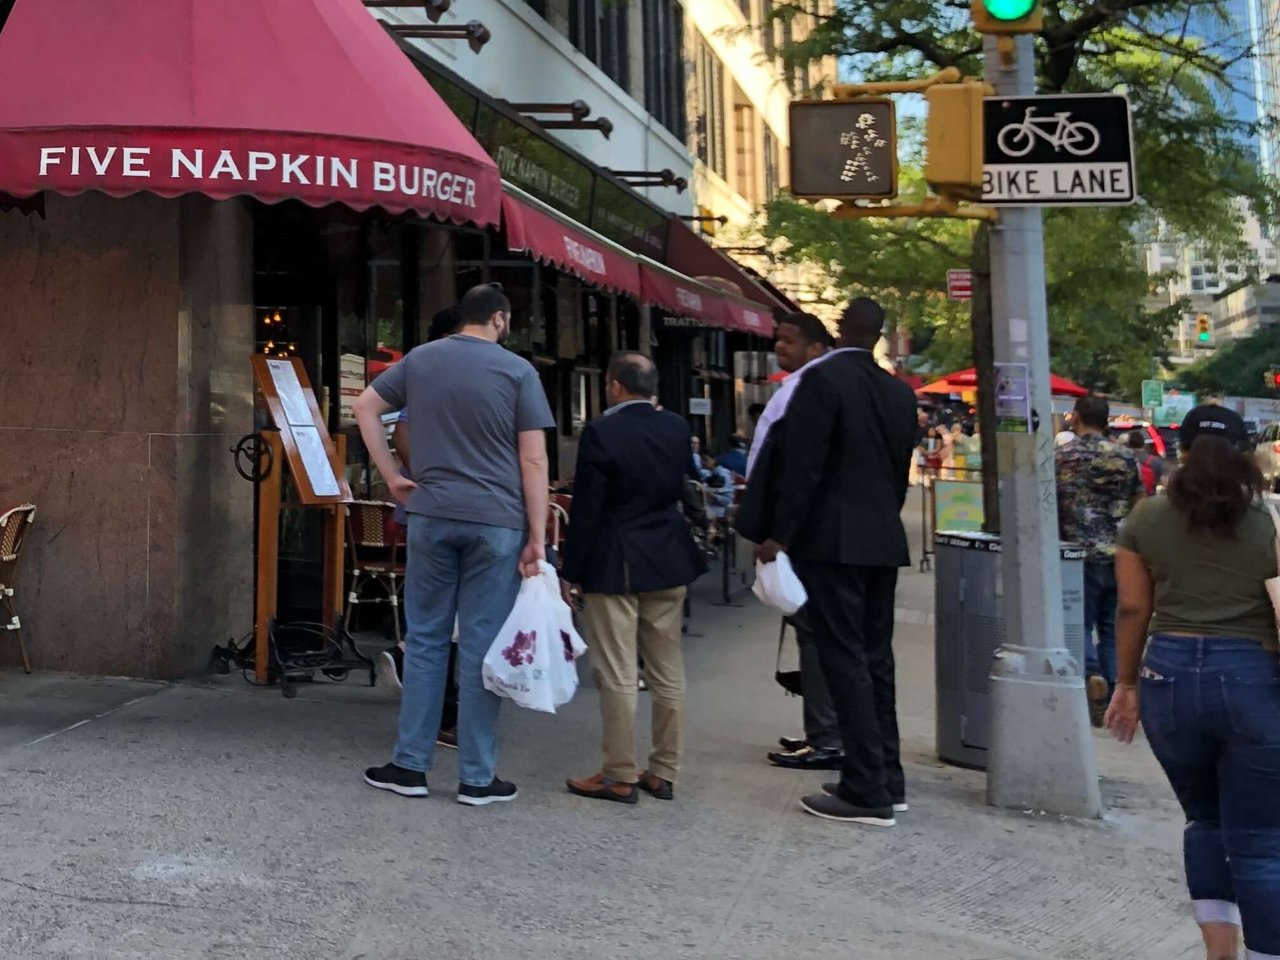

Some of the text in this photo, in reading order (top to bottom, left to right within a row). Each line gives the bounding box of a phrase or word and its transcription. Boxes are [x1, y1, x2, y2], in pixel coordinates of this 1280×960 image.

[38, 146, 477, 208] FIVE NAPKIN BURGER
[982, 168, 1126, 195] BIKE LANE
